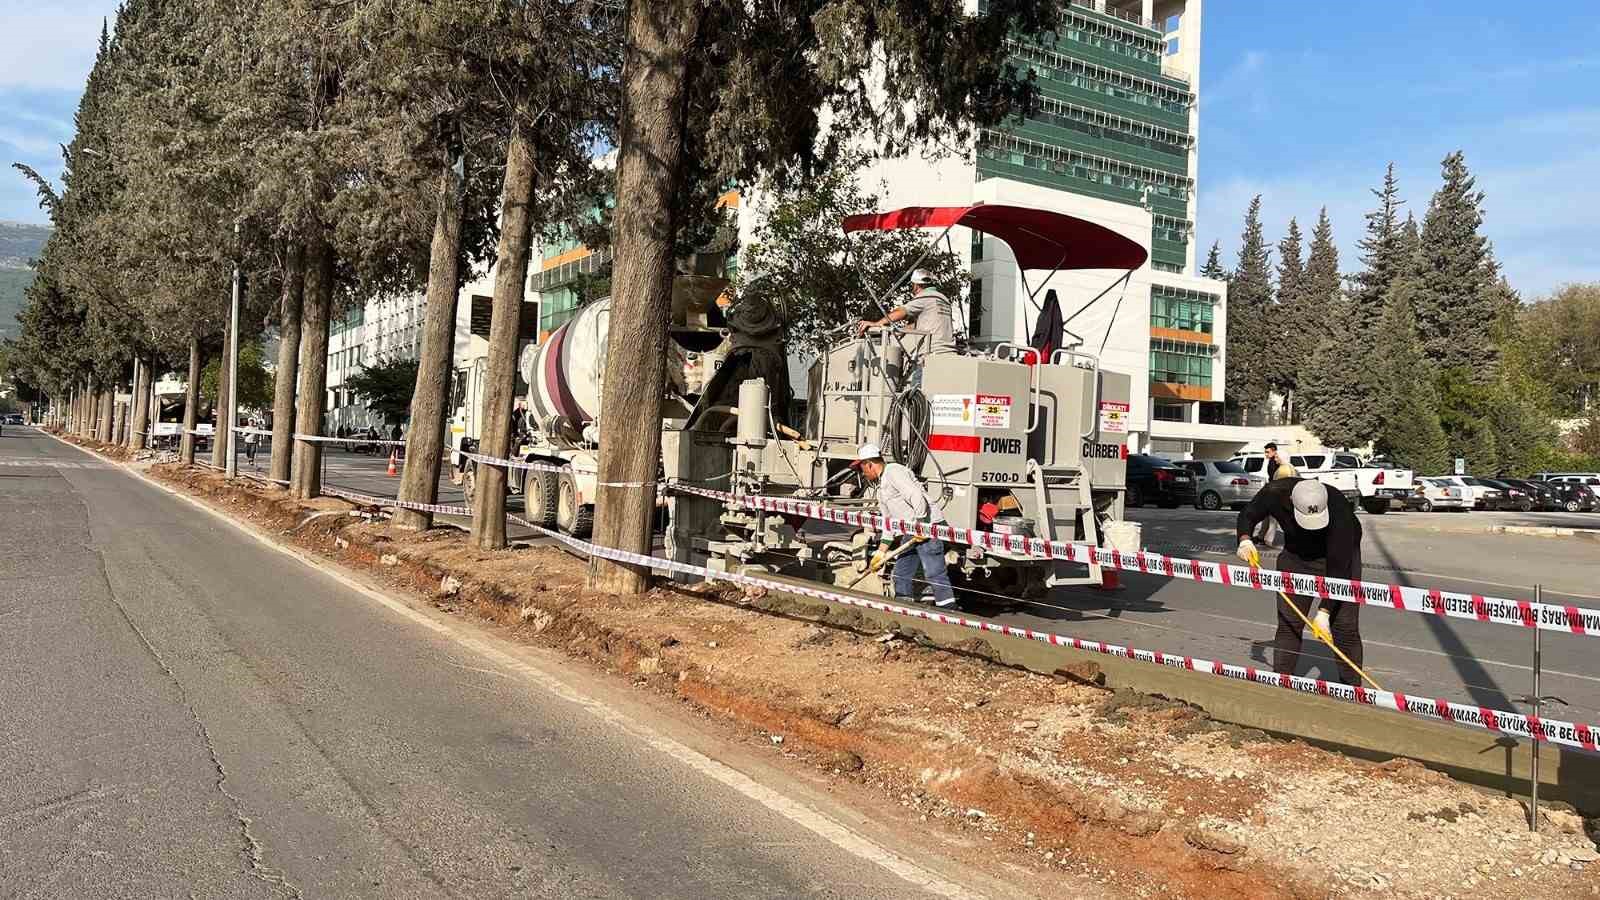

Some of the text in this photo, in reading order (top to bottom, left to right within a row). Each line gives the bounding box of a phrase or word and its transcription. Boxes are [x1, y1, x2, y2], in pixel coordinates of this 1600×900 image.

[983, 437, 1021, 454] POWER
[1082, 443, 1119, 459] CURBER
[981, 471, 1019, 482] 5700-D
[1233, 569, 1272, 586] BELEDİYESİ
[1422, 594, 1474, 614] BELEDİYESİ
[1477, 600, 1538, 624] BÜYÜKŞEHİR
[1329, 687, 1377, 705] BELEDİYESİ
[1493, 713, 1556, 737] BÜYÜKŞEHİR
